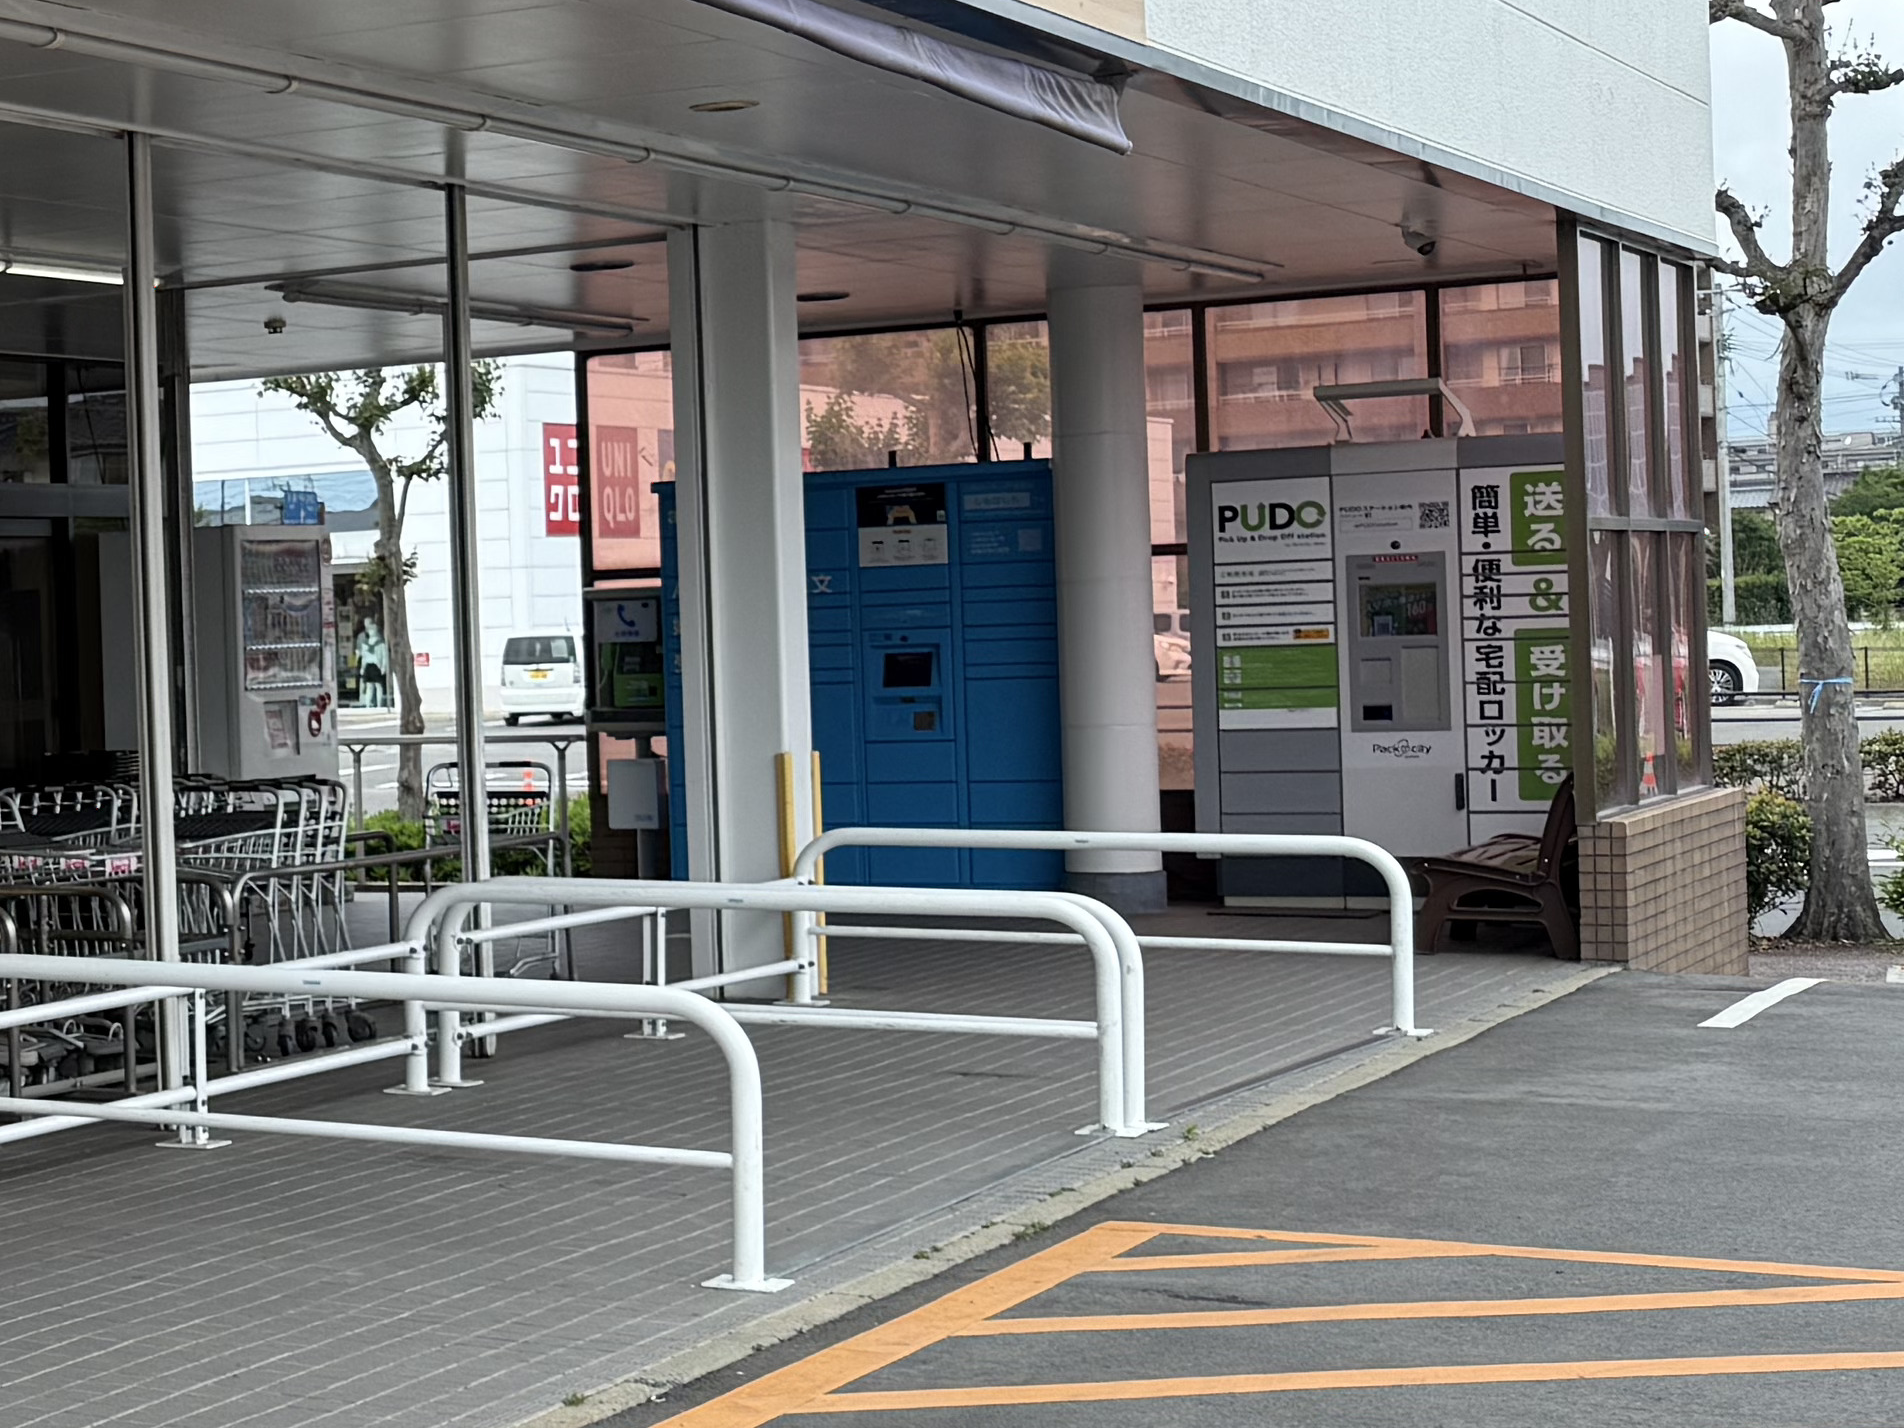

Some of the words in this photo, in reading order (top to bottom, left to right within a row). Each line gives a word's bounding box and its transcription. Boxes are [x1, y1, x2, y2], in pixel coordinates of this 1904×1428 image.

[601, 440, 633, 478] UNI
[603, 485, 636, 530] QLO
[1218, 500, 1327, 533] PUDO
[1471, 483, 1506, 803] 簡単・便利な宅配ロッカー
